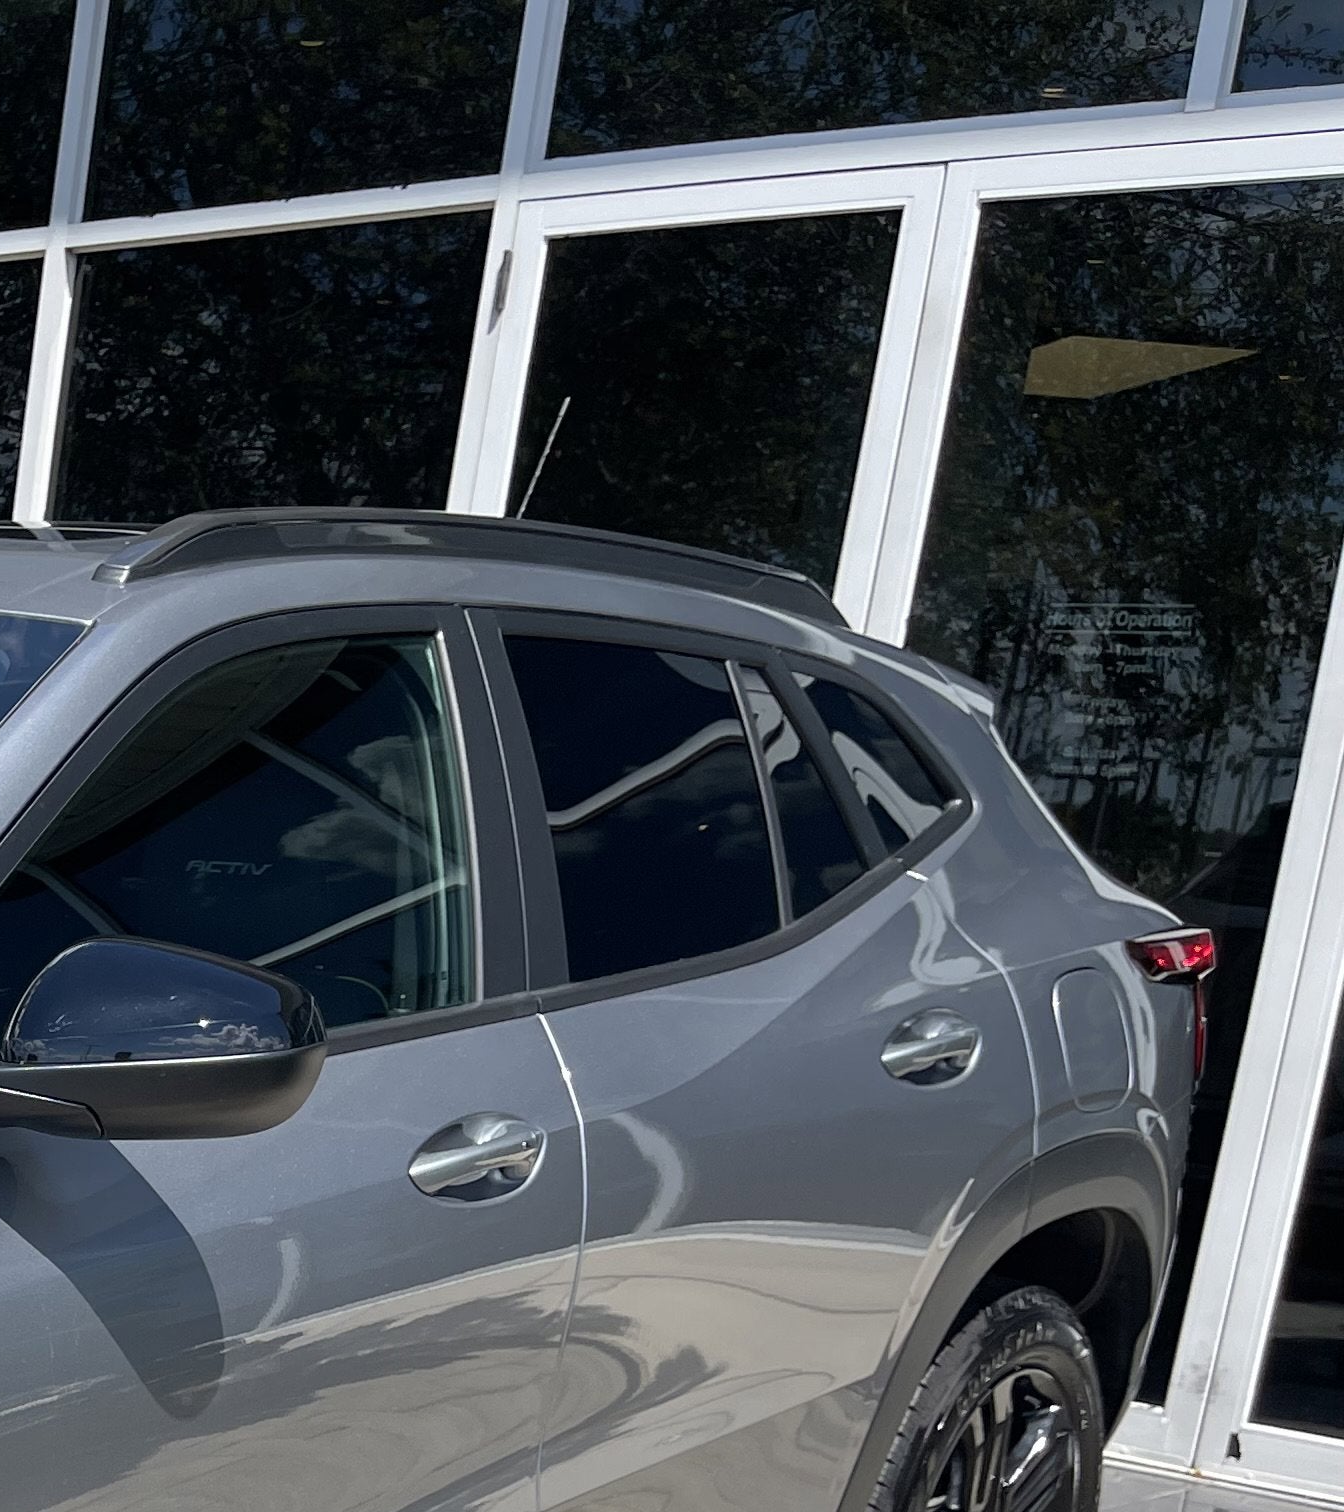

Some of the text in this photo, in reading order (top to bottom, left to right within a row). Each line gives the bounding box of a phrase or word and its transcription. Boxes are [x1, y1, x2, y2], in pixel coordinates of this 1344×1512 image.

[1046, 611, 1091, 627] Hours
[1116, 610, 1192, 630] Operation
[185, 860, 273, 876] ACTIV
